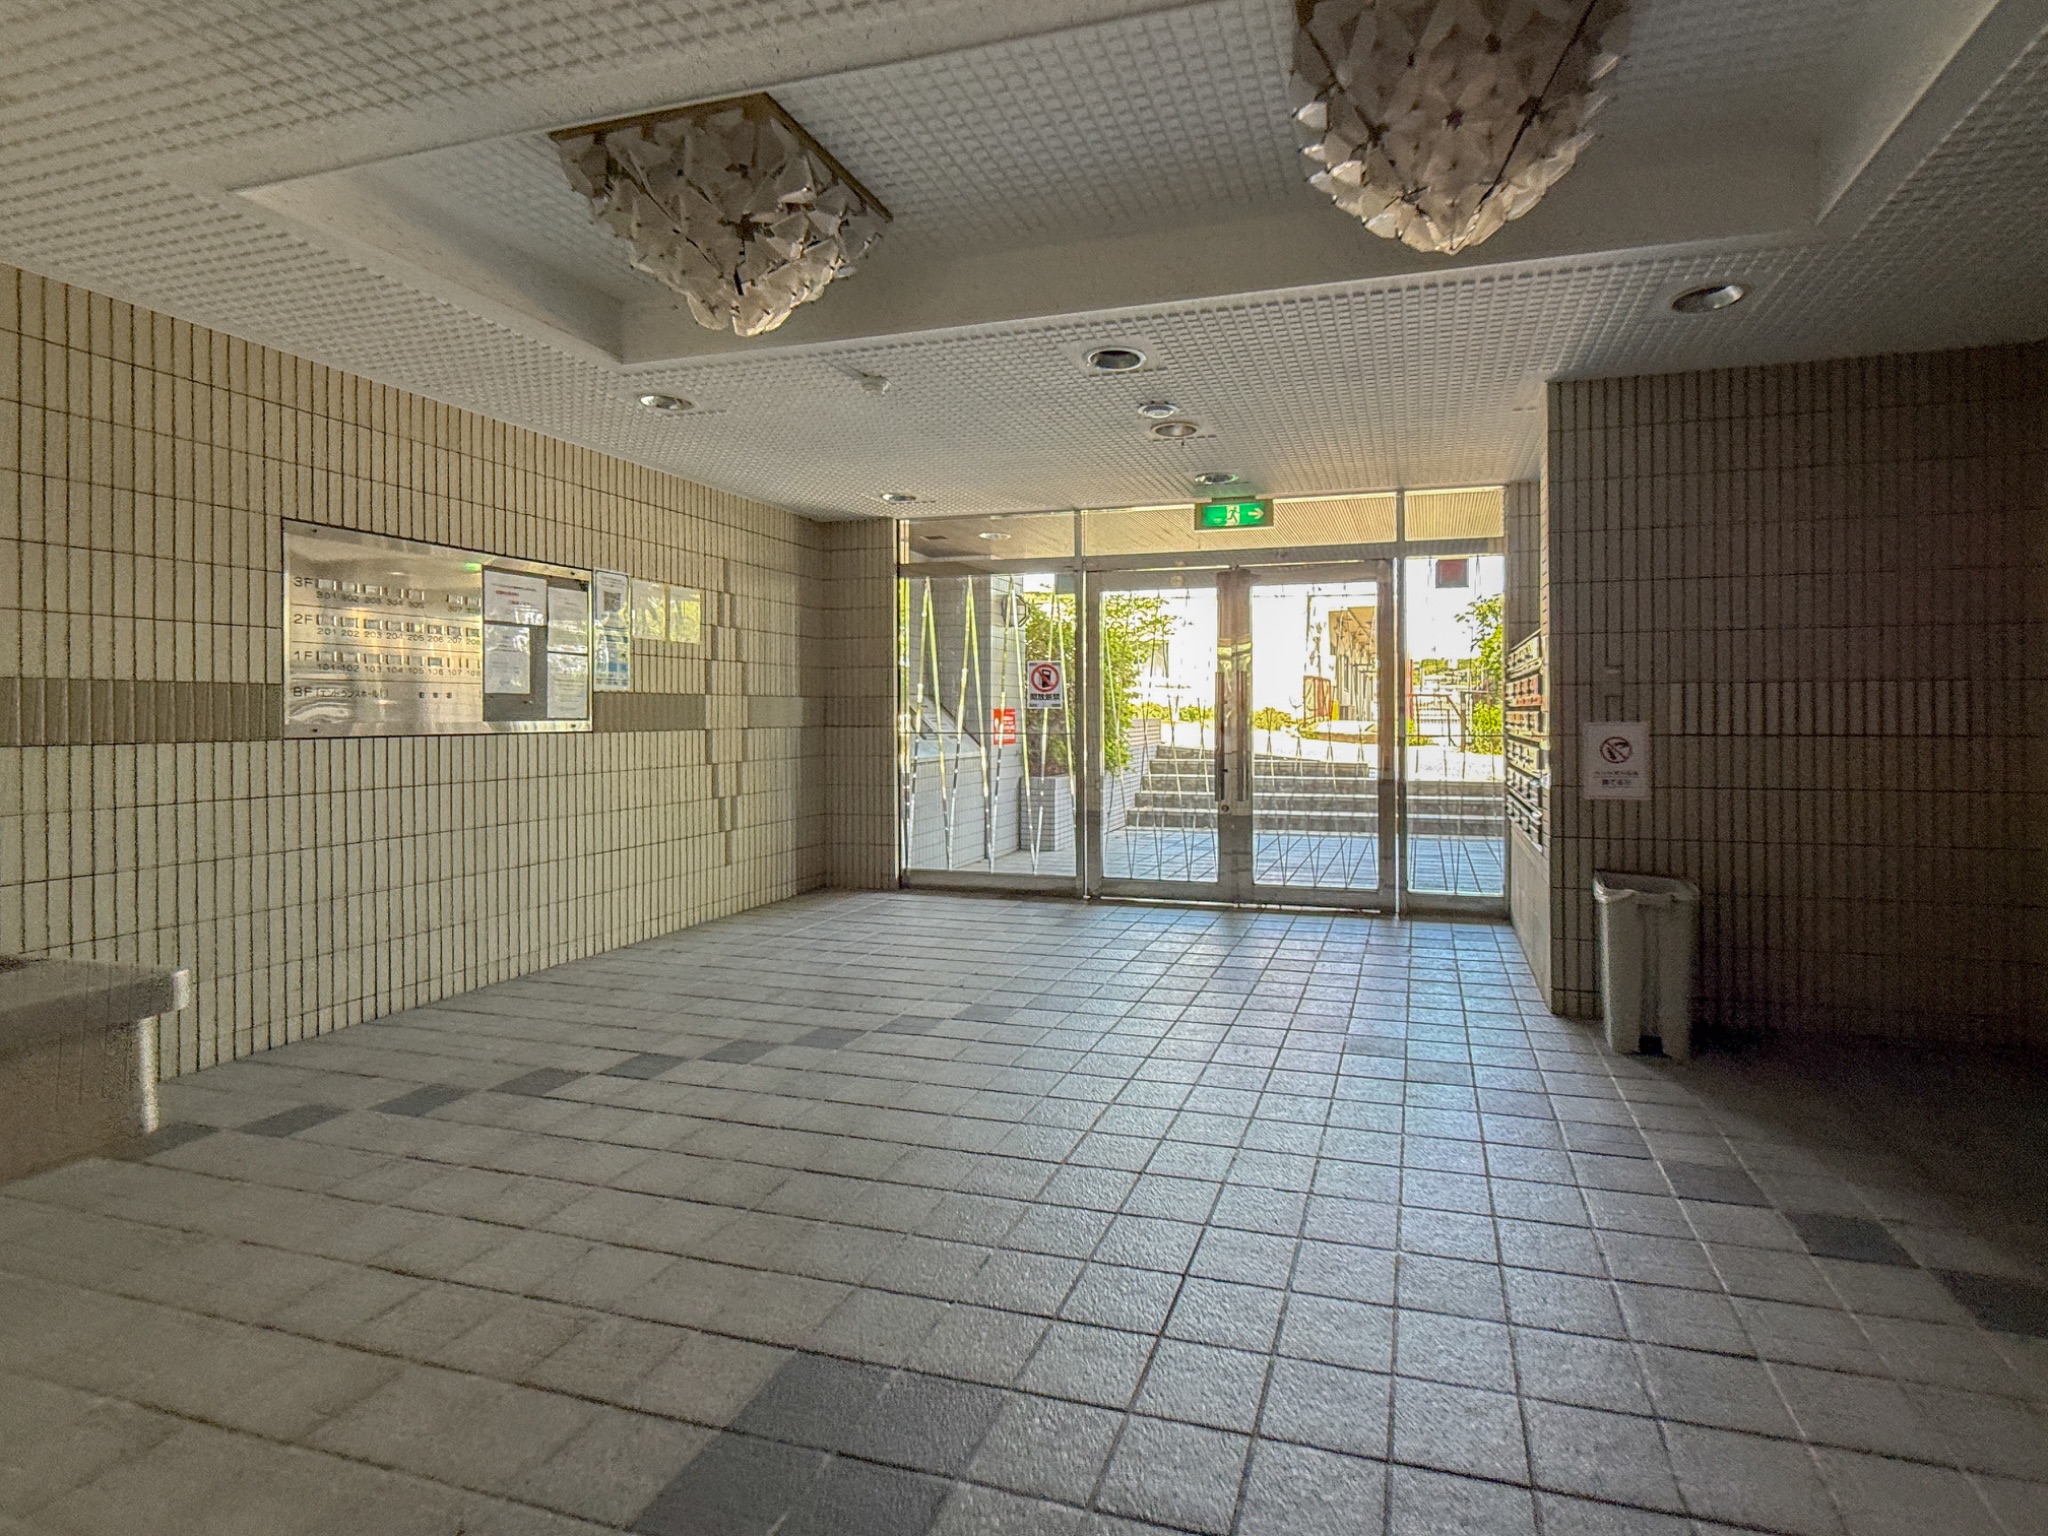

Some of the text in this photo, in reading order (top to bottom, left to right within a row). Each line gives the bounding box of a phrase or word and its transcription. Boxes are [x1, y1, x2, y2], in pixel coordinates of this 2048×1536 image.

[293, 576, 313, 588] 3F
[293, 613, 313, 625] 2F
[341, 629, 359, 638] 202
[364, 631, 382, 639] 203
[386, 632, 403, 640] 204
[428, 635, 444, 643] 206
[447, 636, 462, 644] 207
[294, 650, 313, 661] 1F
[317, 663, 335, 671] 101
[341, 664, 359, 672] 102
[364, 665, 382, 673] 103
[408, 667, 424, 675] 105
[293, 686, 312, 697] BF
